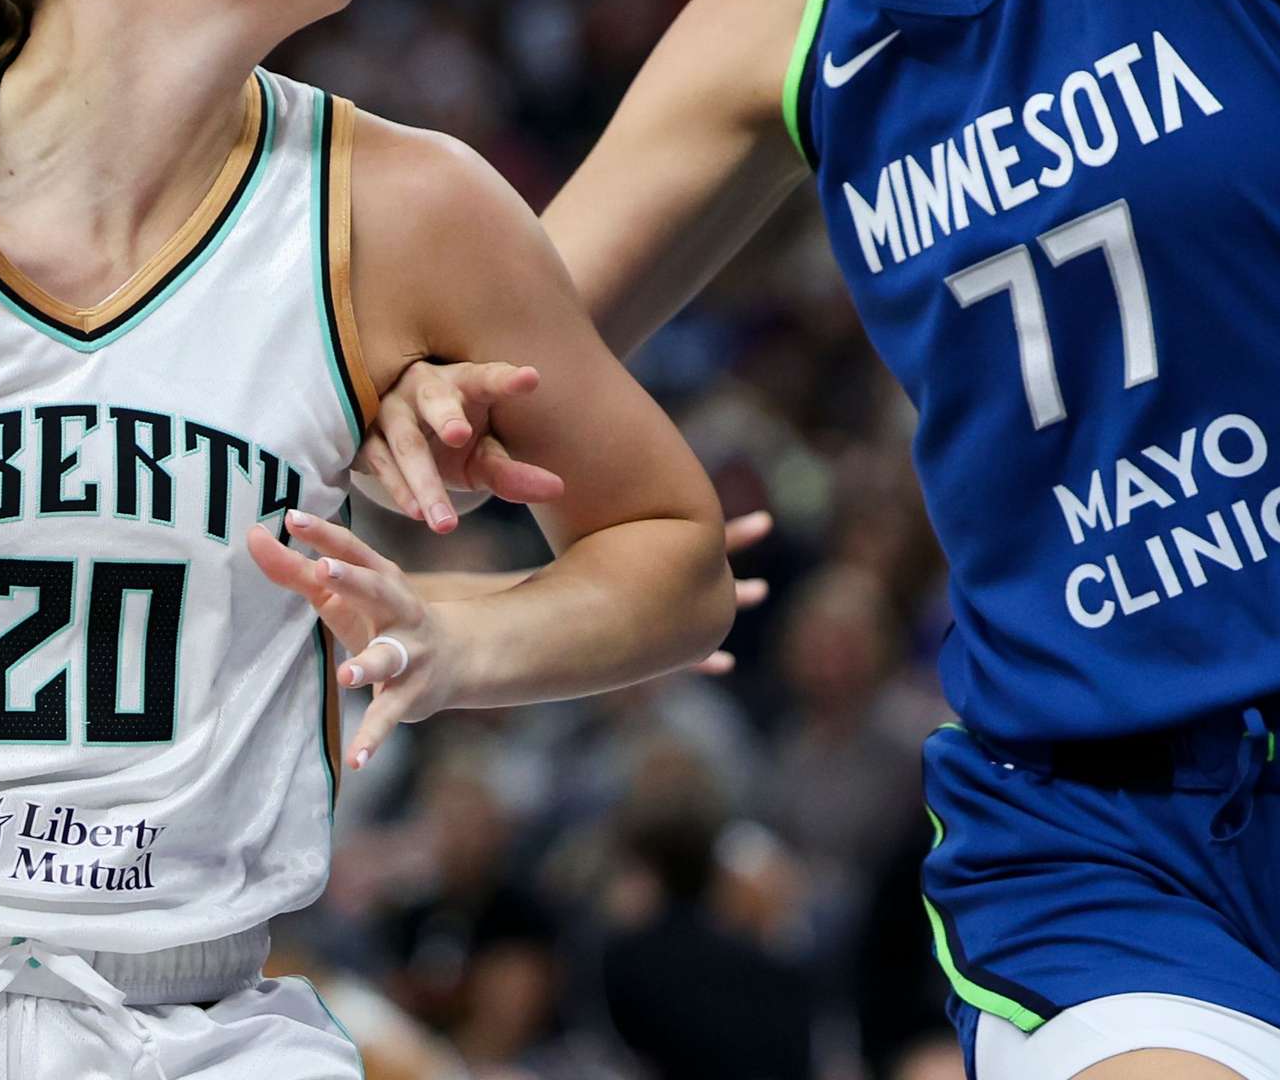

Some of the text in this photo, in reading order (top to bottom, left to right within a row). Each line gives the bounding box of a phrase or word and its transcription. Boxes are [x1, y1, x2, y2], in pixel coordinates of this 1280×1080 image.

[842, 31, 1223, 273] MINNESOTA
[943, 198, 1158, 430] 77
[1053, 414, 1268, 545] MAYO
[8, 846, 156, 892] Mutual
[17, 801, 167, 850] Liberty
